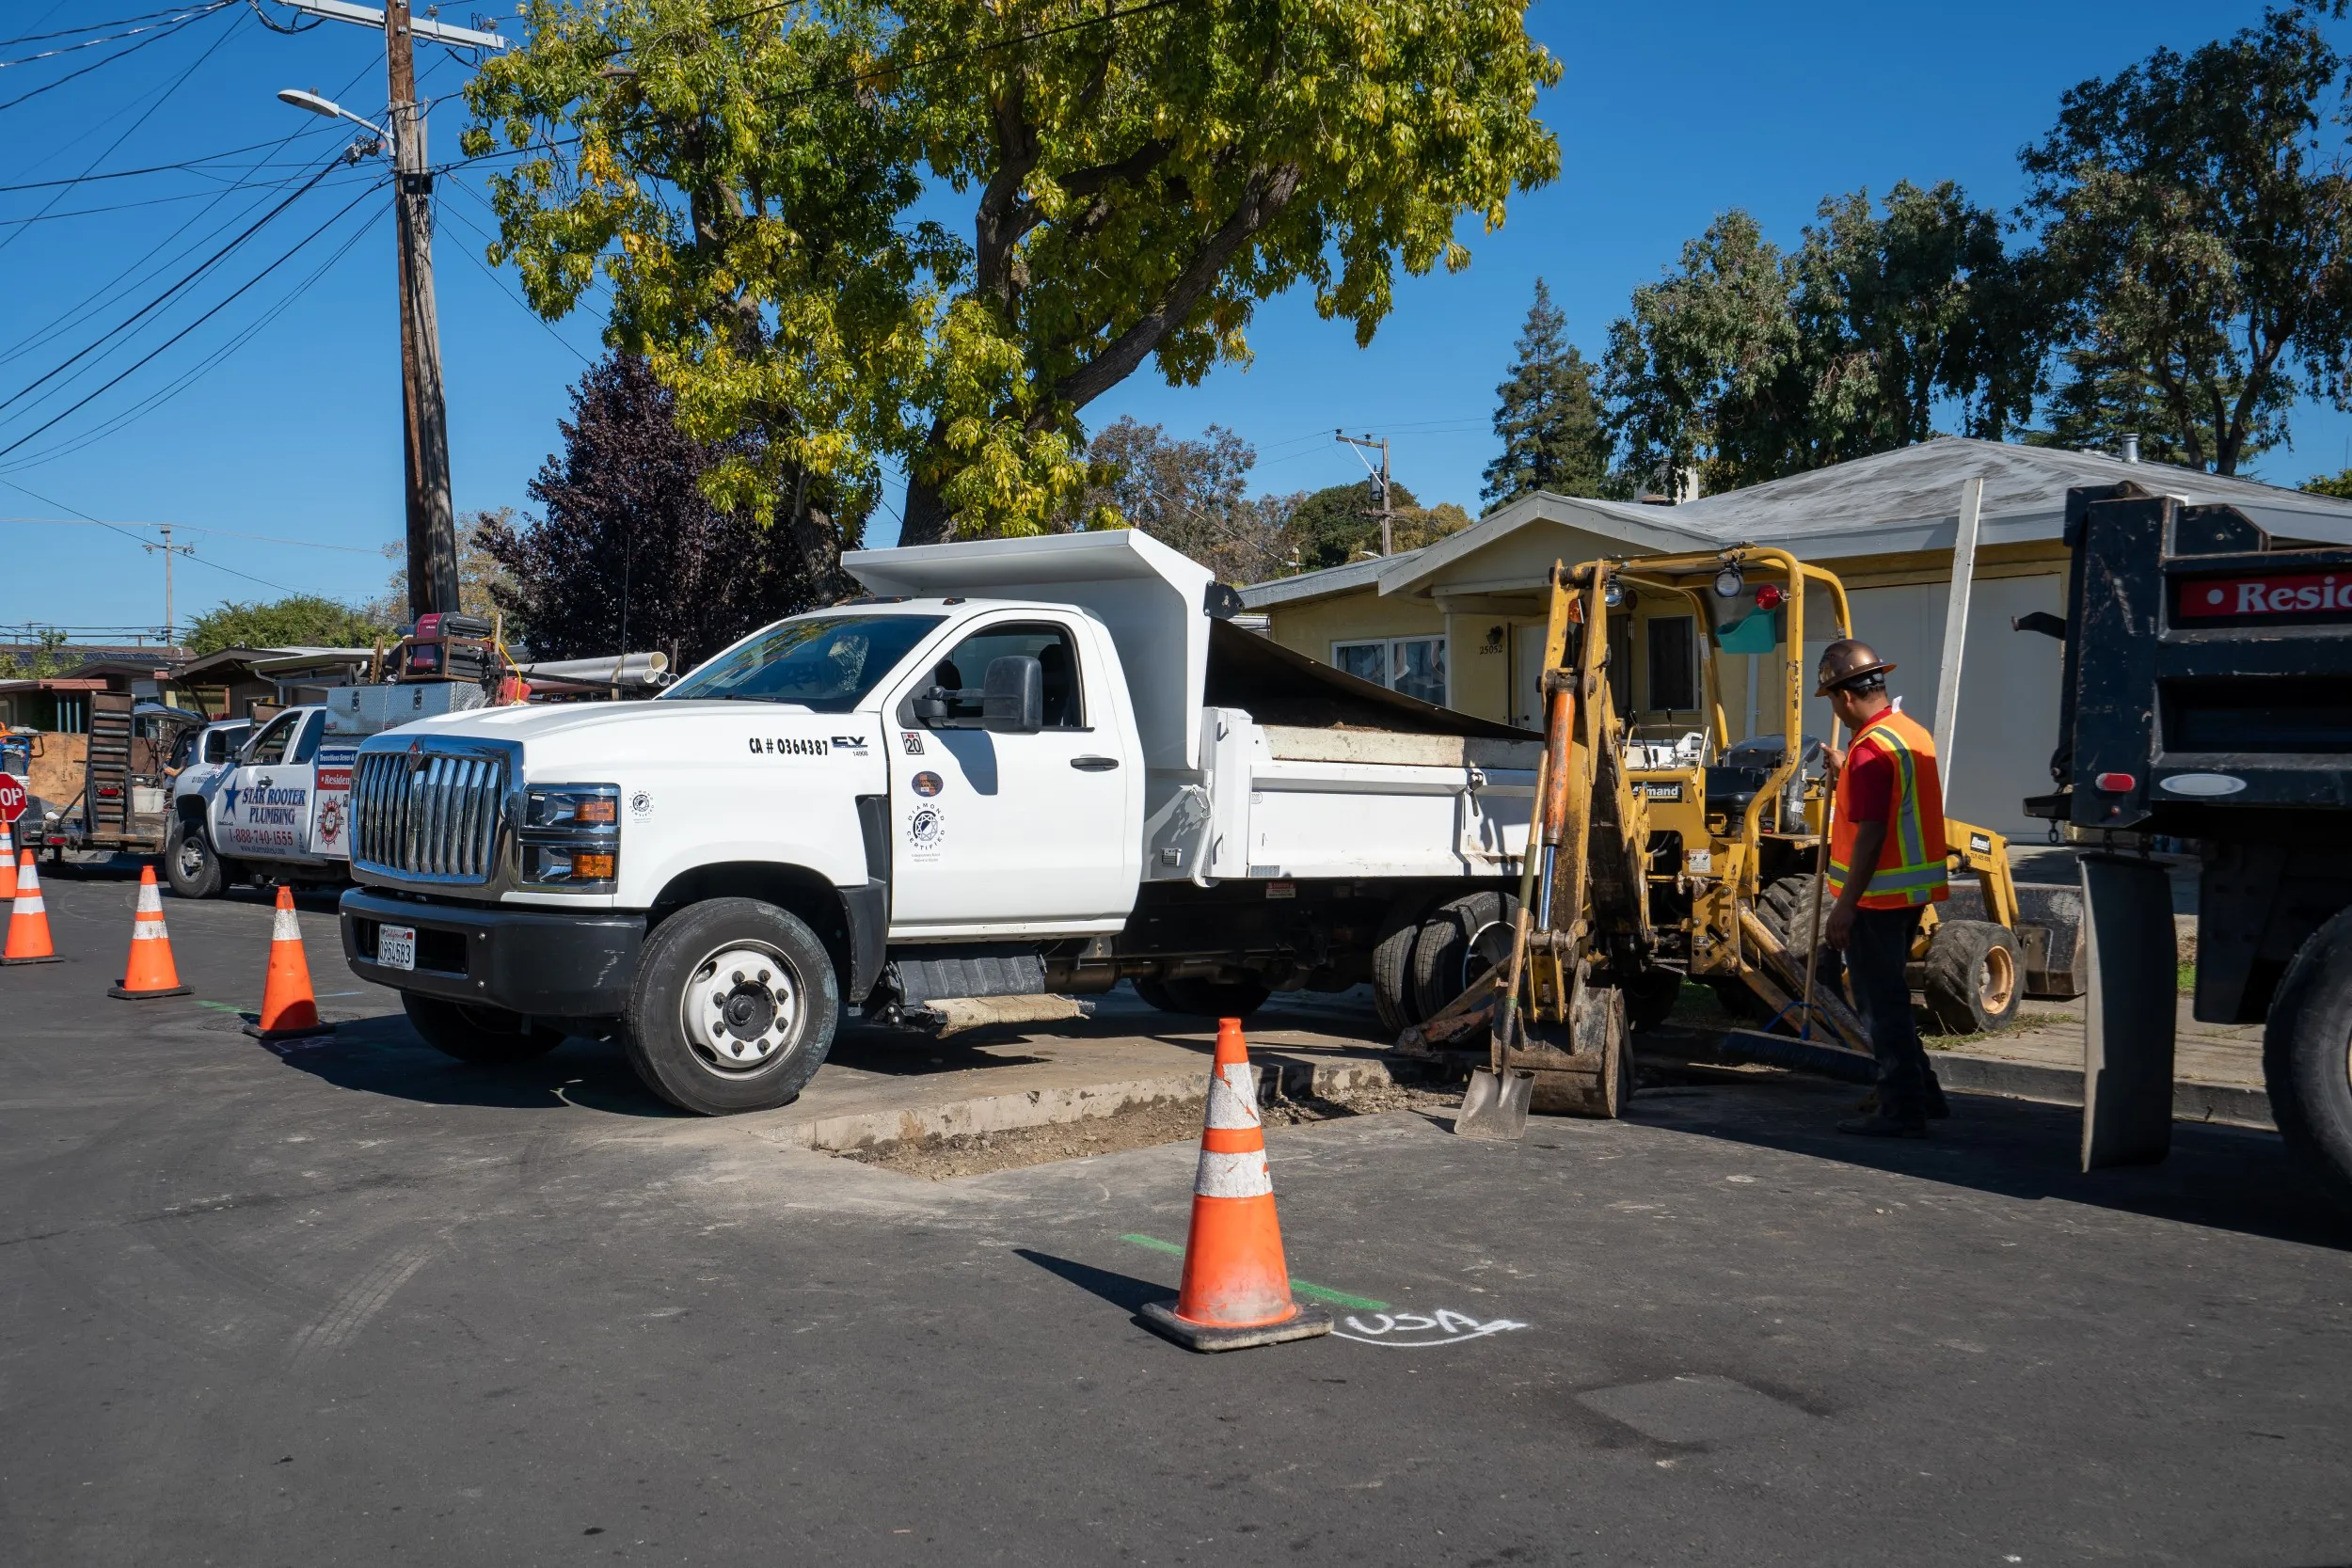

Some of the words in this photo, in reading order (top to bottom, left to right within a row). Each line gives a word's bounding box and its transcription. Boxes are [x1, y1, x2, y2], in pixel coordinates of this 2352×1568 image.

[1479, 644, 1503, 655] 25052
[749, 737, 763, 754] CA
[766, 738, 774, 754] #
[777, 738, 829, 755] 0364387
[905, 738, 921, 752] 20
[242, 788, 265, 805] STAR
[267, 789, 306, 806] ROOTER
[1631, 785, 1678, 797] Amand
[248, 806, 296, 825] PLUMBING
[907, 802, 945, 821] DIAMOND
[906, 830, 946, 850] CERTIFIED
[1345, 1308, 1481, 1335] USA
